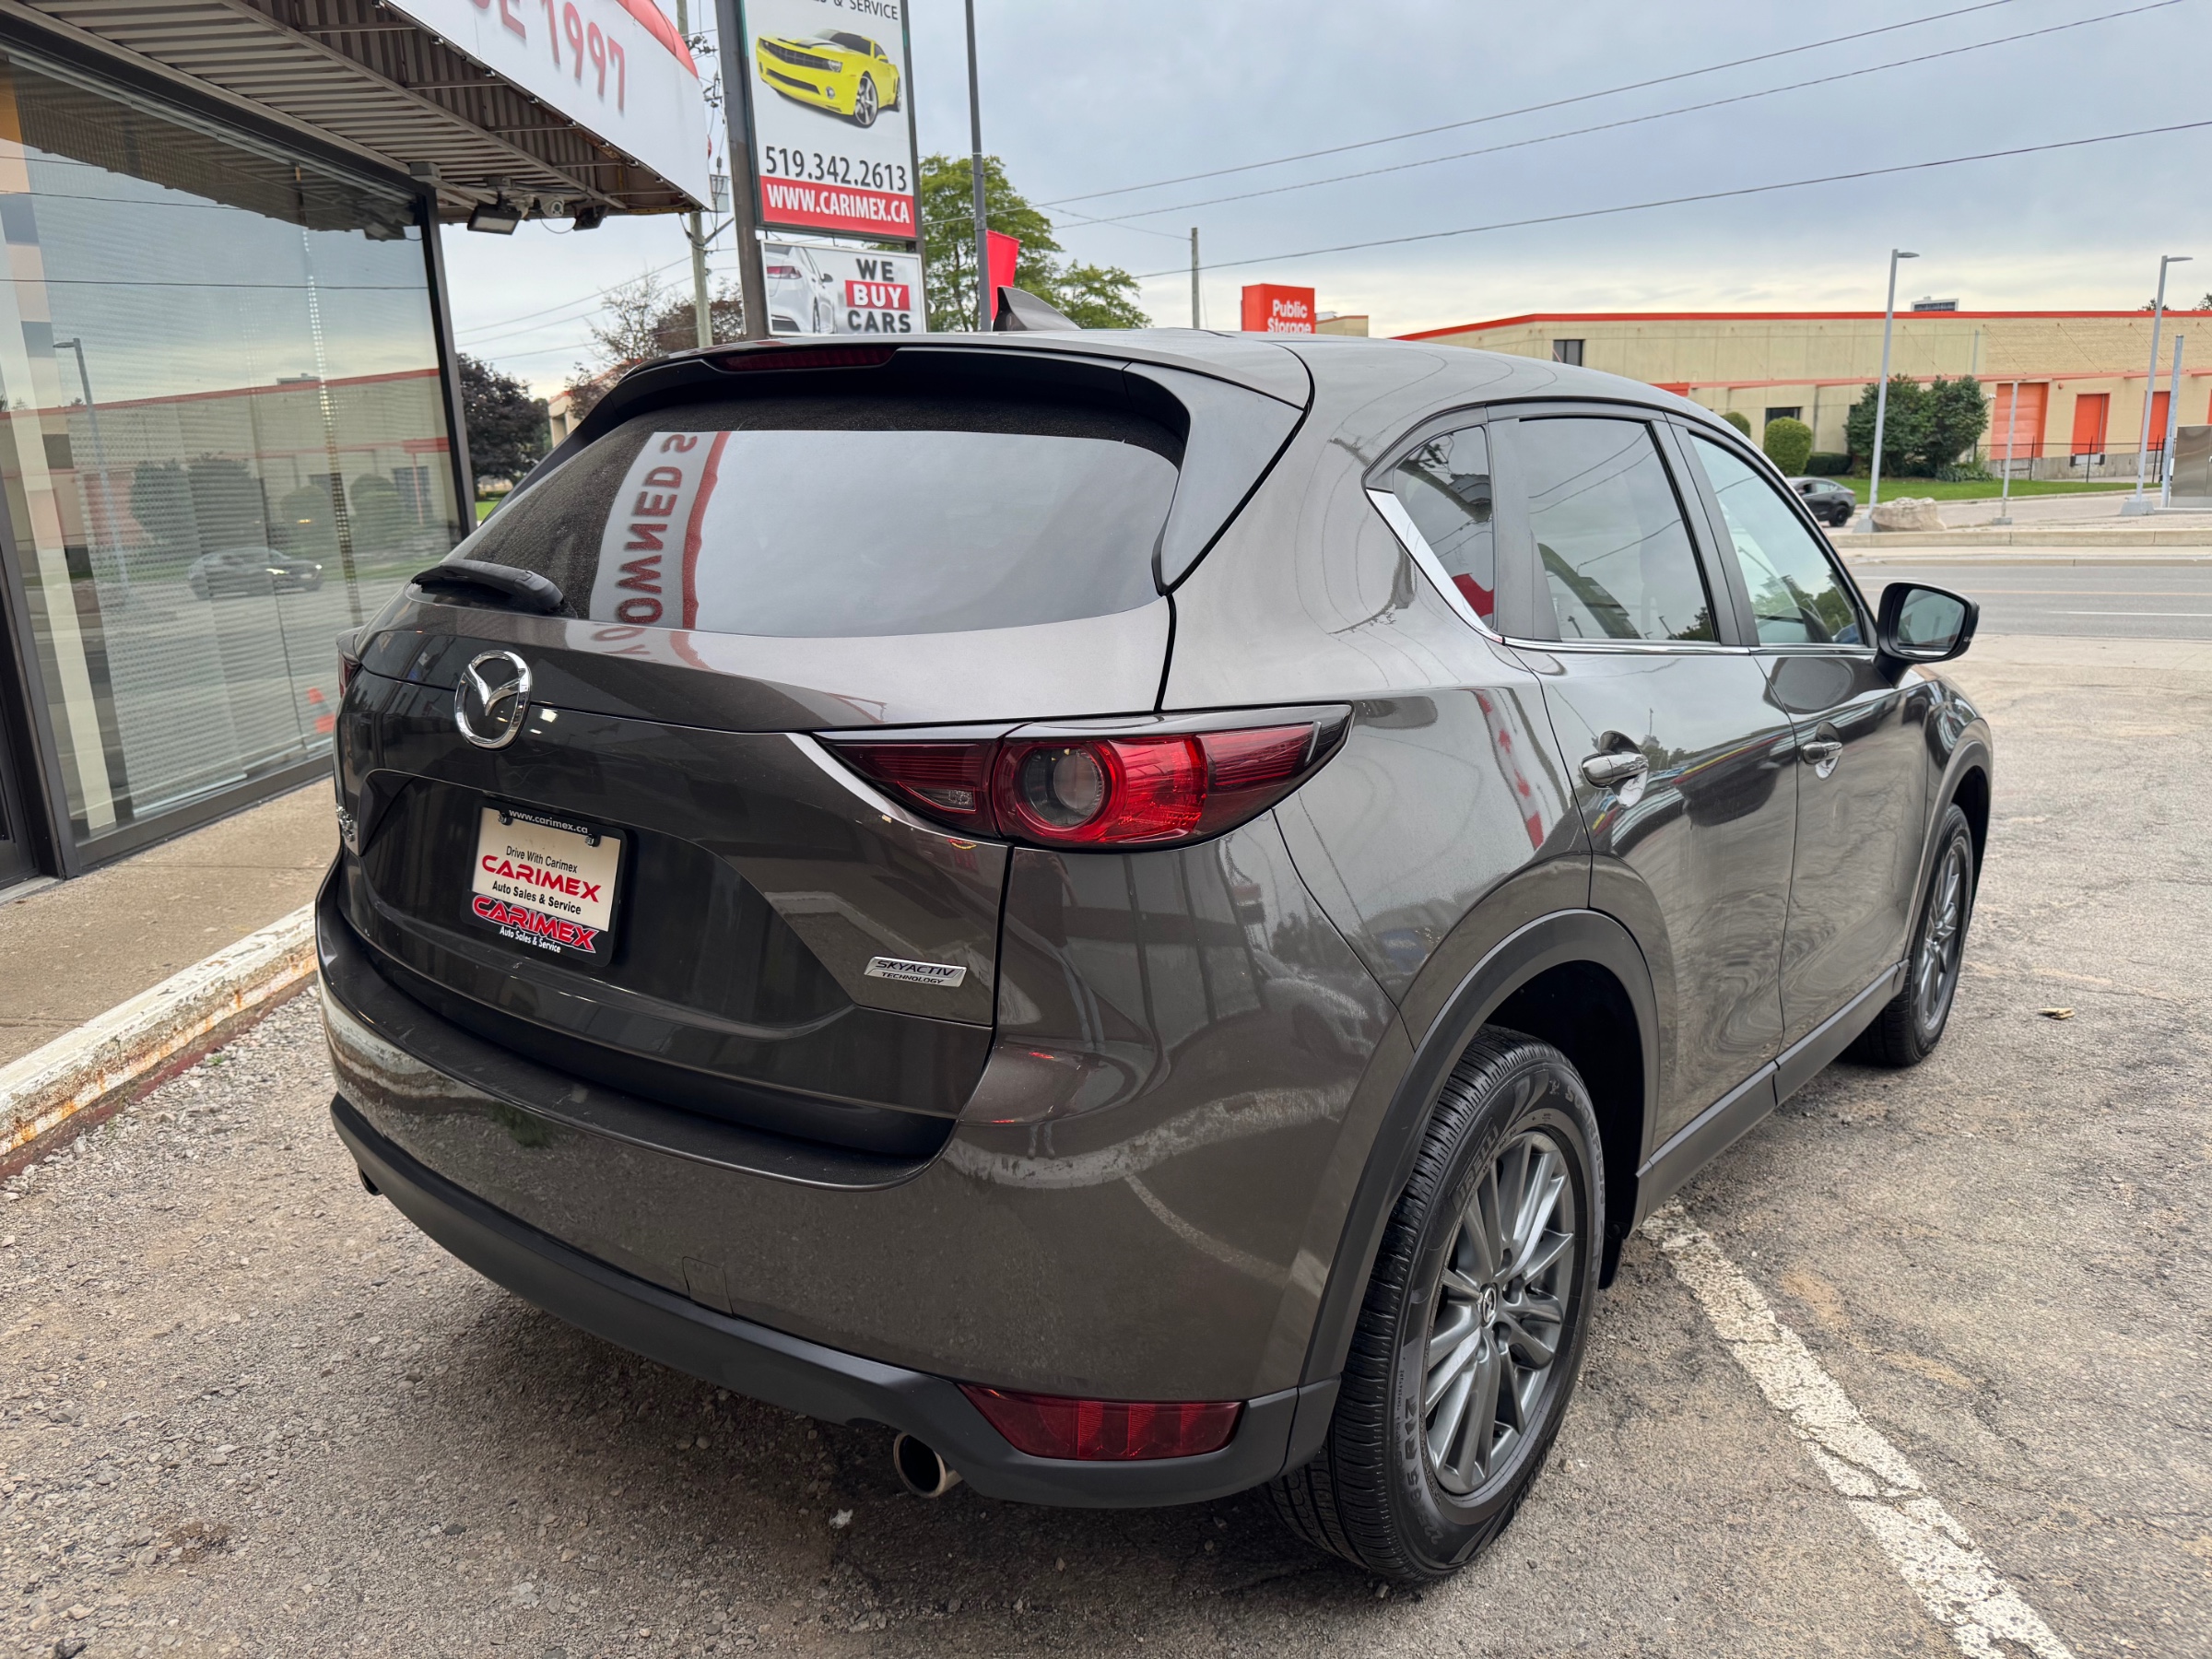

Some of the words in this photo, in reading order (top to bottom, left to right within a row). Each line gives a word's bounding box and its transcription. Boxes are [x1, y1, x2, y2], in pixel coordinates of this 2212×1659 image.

[850, 0, 899, 20] SERVICE
[541, 0, 625, 111] 1997
[766, 146, 907, 192] 519.342.2613
[767, 183, 910, 224] WWW.CARIMEX.CA
[855, 258, 894, 282] WE
[853, 284, 902, 309] BUY
[1273, 300, 1307, 318] Public
[847, 310, 912, 334] CARS
[509, 809, 588, 834] www.carimex.ca
[506, 845, 525, 860] Drive
[527, 850, 544, 865] With
[545, 856, 578, 874] Carimex
[481, 854, 602, 903] CARIMEX
[492, 880, 511, 895] Auto
[512, 886, 536, 902] Sales
[538, 894, 546, 905] &
[548, 897, 582, 915] Service
[472, 895, 599, 953] CARIMEX
[500, 925, 514, 939] Auto
[515, 931, 532, 945] Sales
[532, 935, 538, 946] &
[538, 938, 561, 954] Service
[876, 960, 956, 977] SKYACTIV
[881, 971, 945, 984] TECHNOLOGY
